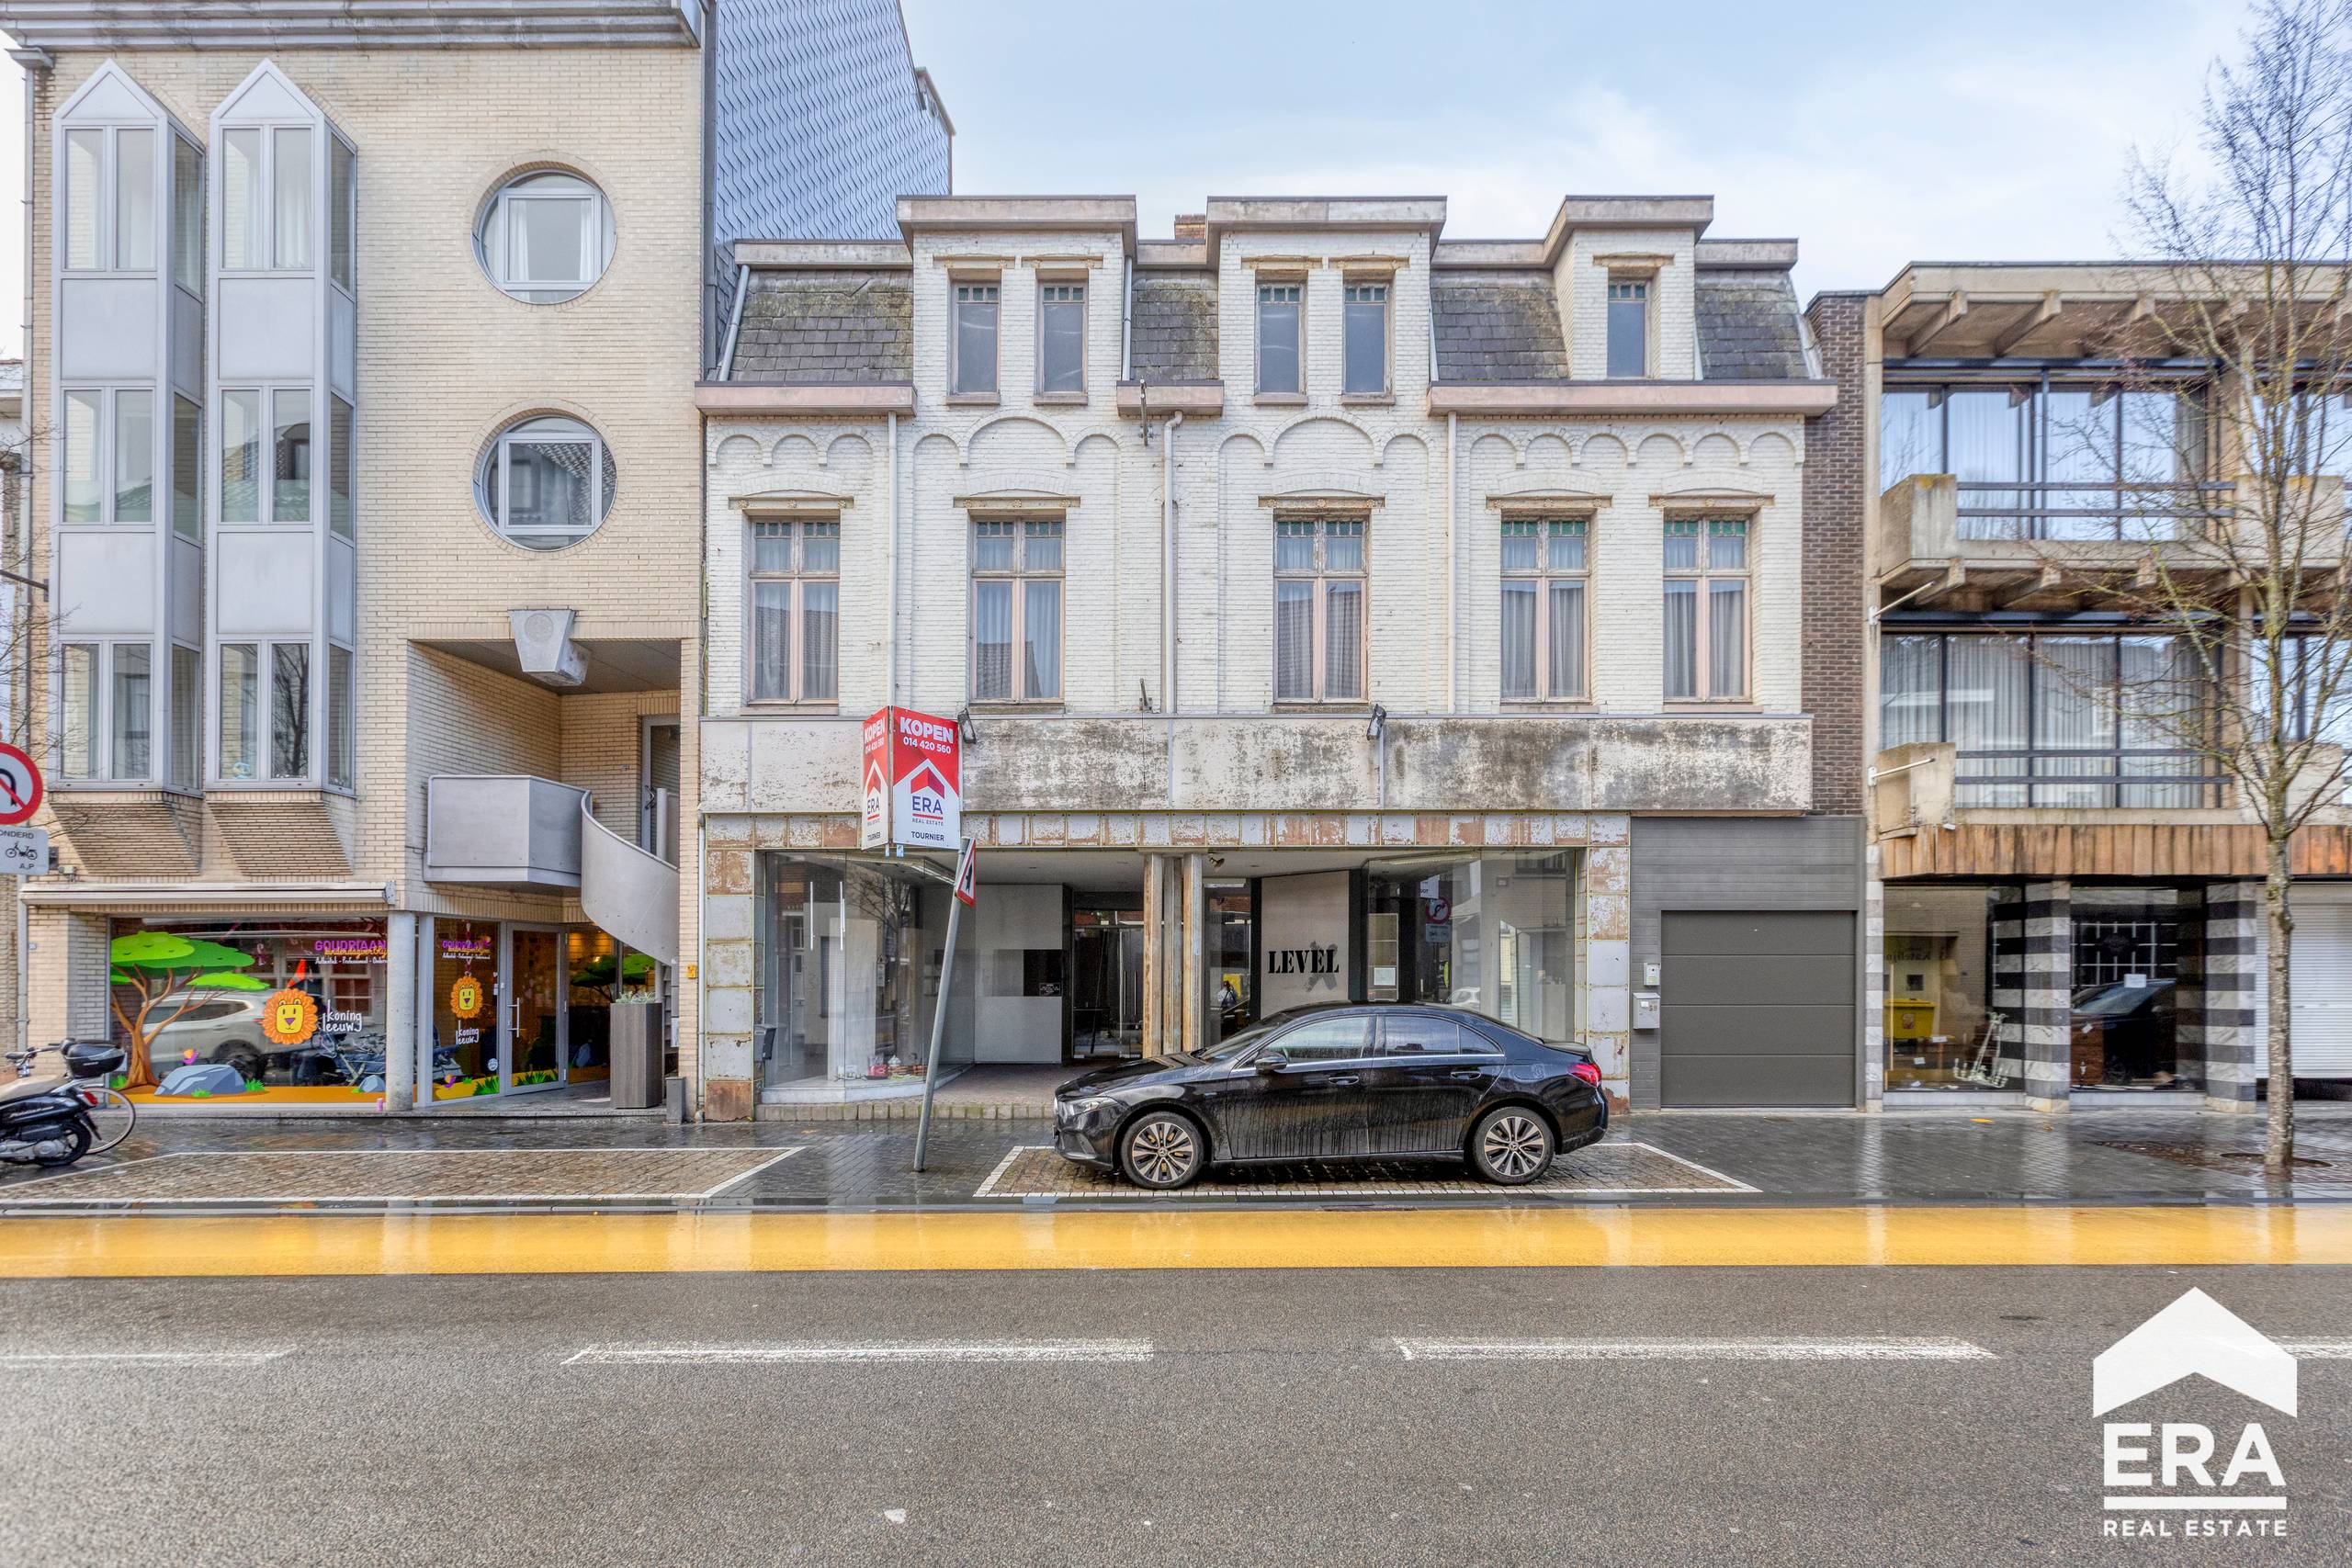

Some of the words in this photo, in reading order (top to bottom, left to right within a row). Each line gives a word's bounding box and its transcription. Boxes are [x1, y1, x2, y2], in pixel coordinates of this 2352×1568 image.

[865, 717, 886, 744] KOPEN
[900, 716, 954, 744] KOPEN
[903, 736, 918, 748] 014
[920, 739, 935, 750] 420
[937, 745, 951, 754] 560
[867, 796, 880, 815] ERA
[912, 795, 944, 815] ERA
[911, 830, 944, 841] TOURNIER
[315, 940, 386, 951] GOUDRIAAN
[1268, 949, 1340, 974] LEVEL
[322, 1012, 355, 1032] leeuw
[327, 998, 363, 1032] koning
